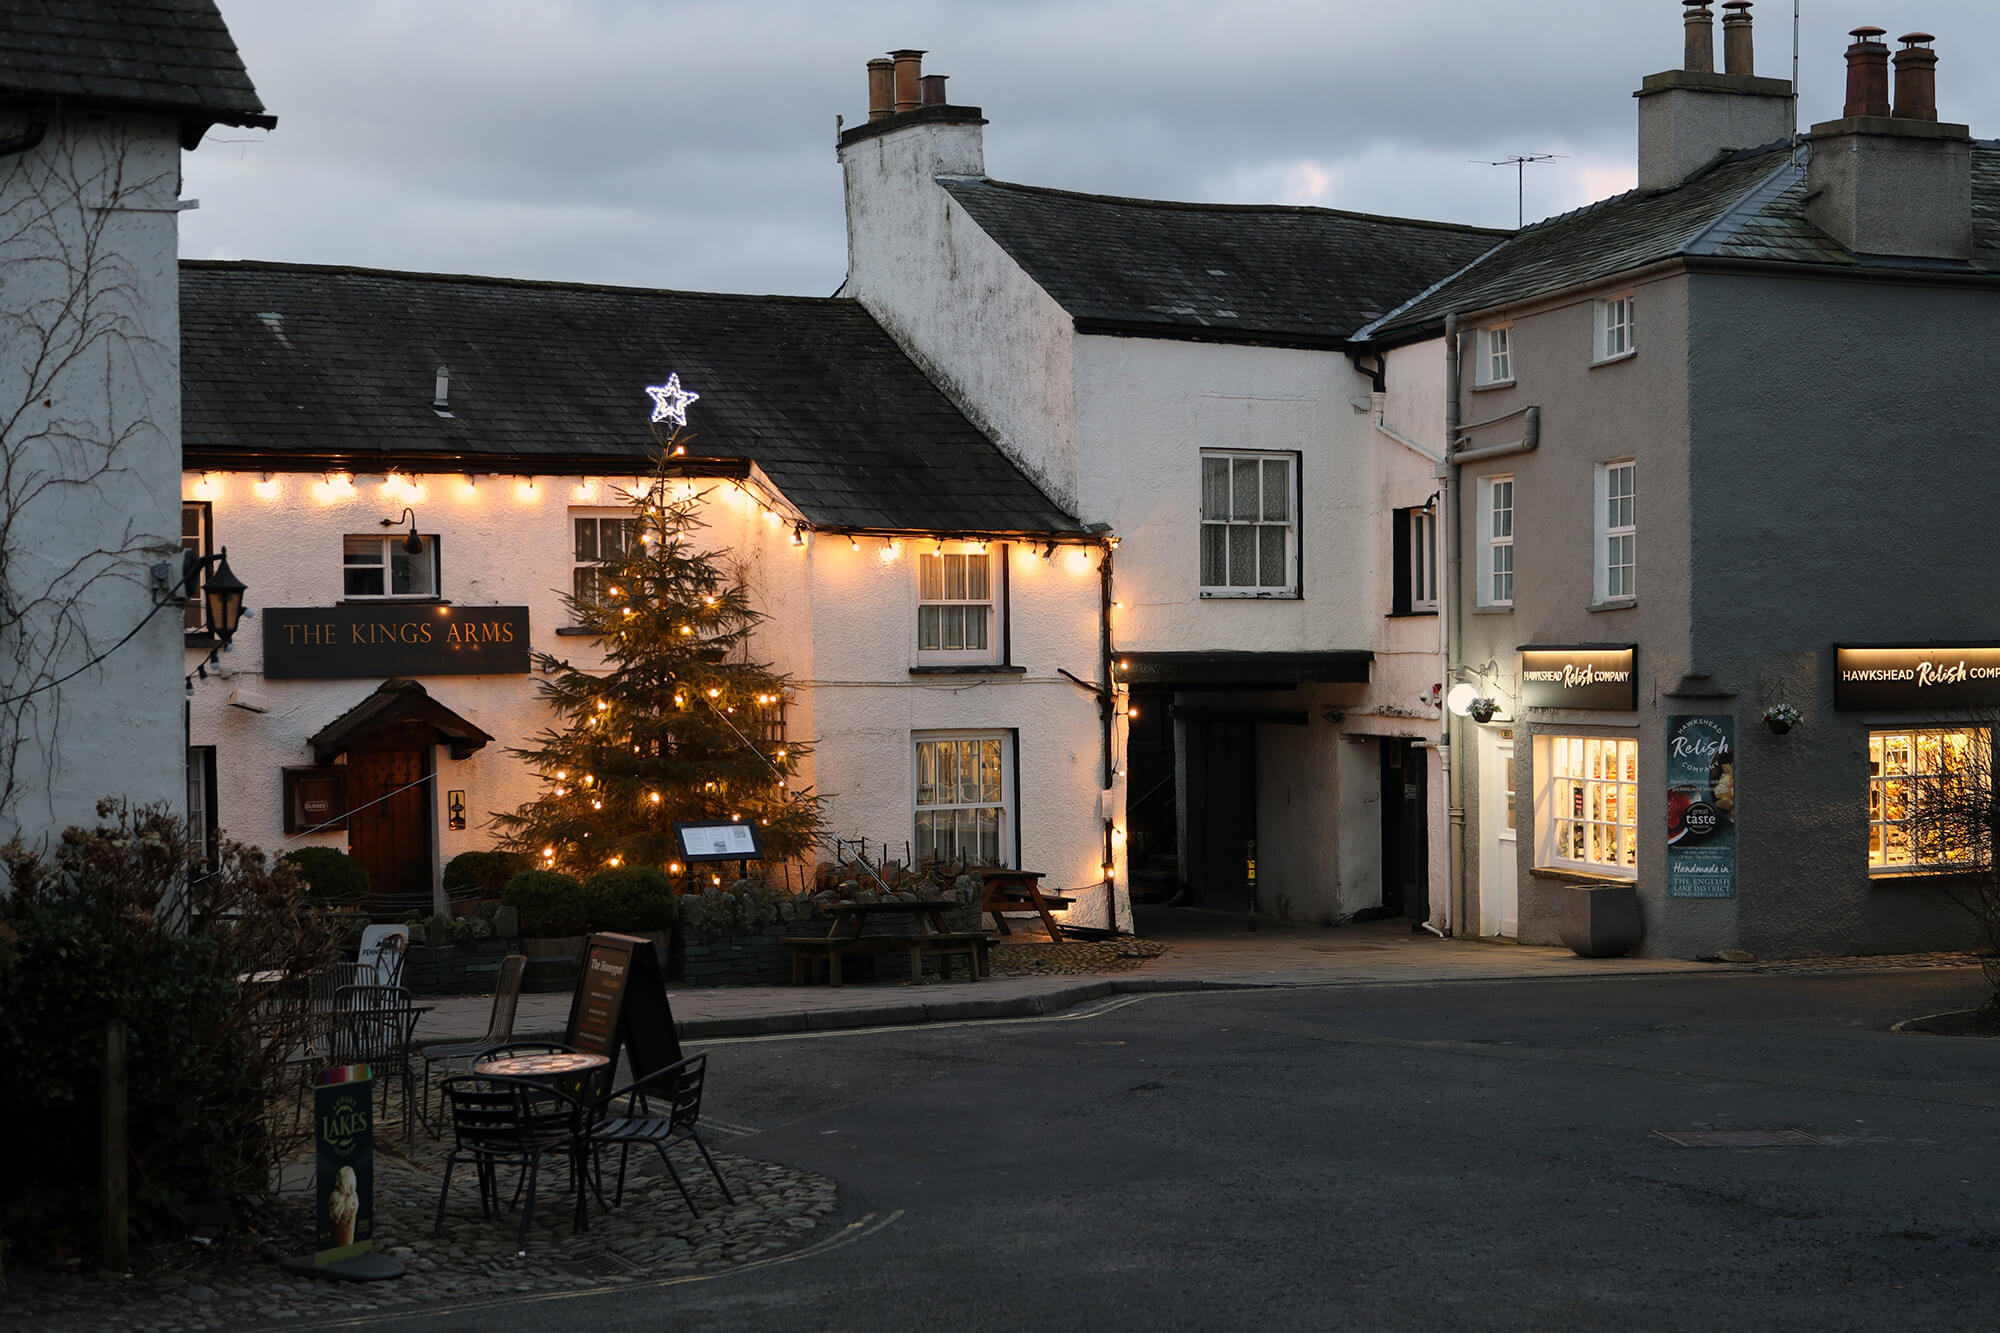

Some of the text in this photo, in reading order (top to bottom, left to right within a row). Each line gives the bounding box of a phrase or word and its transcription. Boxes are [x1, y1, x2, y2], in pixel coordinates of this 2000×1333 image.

[282, 621, 514, 645] THE KINGS ARMS
[1523, 663, 1630, 689] HAWKSHEAD Relish COMPANY
[1842, 669, 1914, 681] HAWKSHEAD
[1916, 660, 1967, 688] Relish
[1678, 718, 1722, 735] HAWKSHEAD
[1670, 735, 1729, 759] Relish
[1681, 760, 1720, 773] COMPANY
[1686, 814, 1716, 825] taste
[1673, 862, 1730, 874] Handmade in
[591, 958, 600, 970] The
[322, 1111, 367, 1145] LAKES
